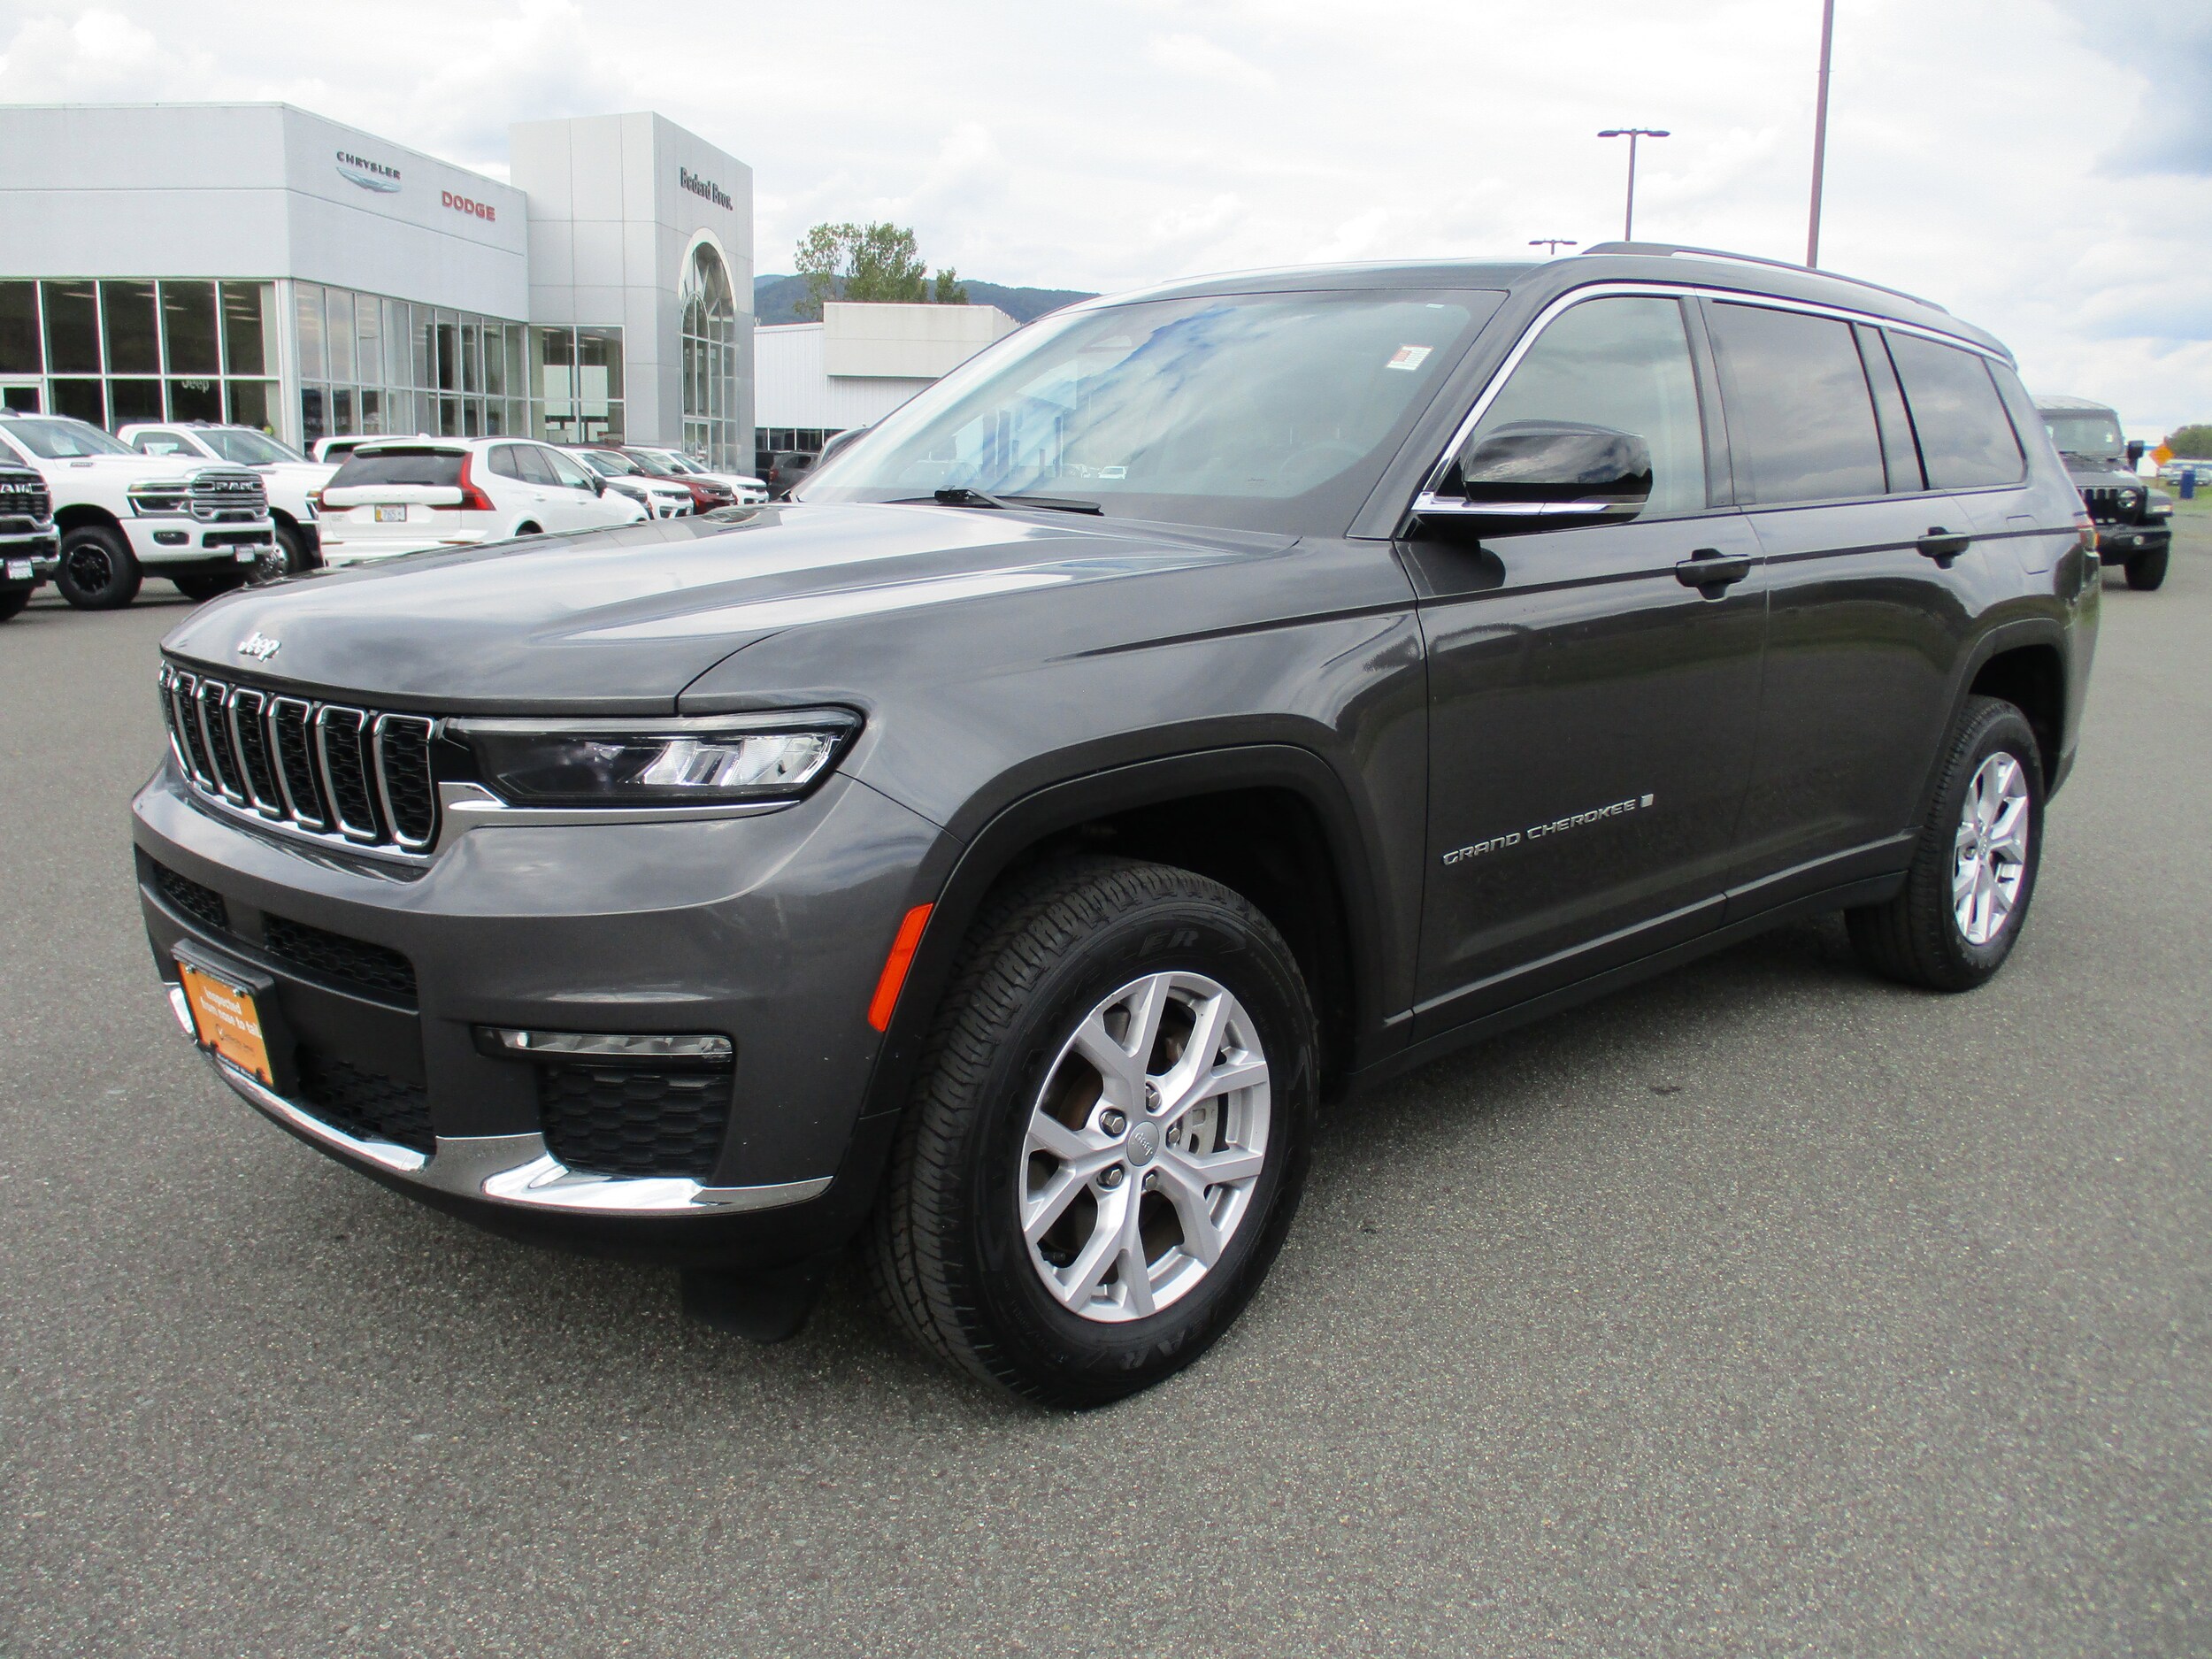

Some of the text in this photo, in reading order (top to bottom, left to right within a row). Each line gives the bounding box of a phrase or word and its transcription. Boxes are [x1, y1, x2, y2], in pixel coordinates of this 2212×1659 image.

[336, 151, 401, 180] CHRYSLER
[442, 190, 495, 221] DODGE
[712, 182, 733, 211] Bros.
[216, 481, 254, 490] RAM
[237, 632, 281, 663] Jeep
[1442, 799, 1636, 865] GRAND CHEROKEE
[1134, 1132, 1154, 1156] Jeep
